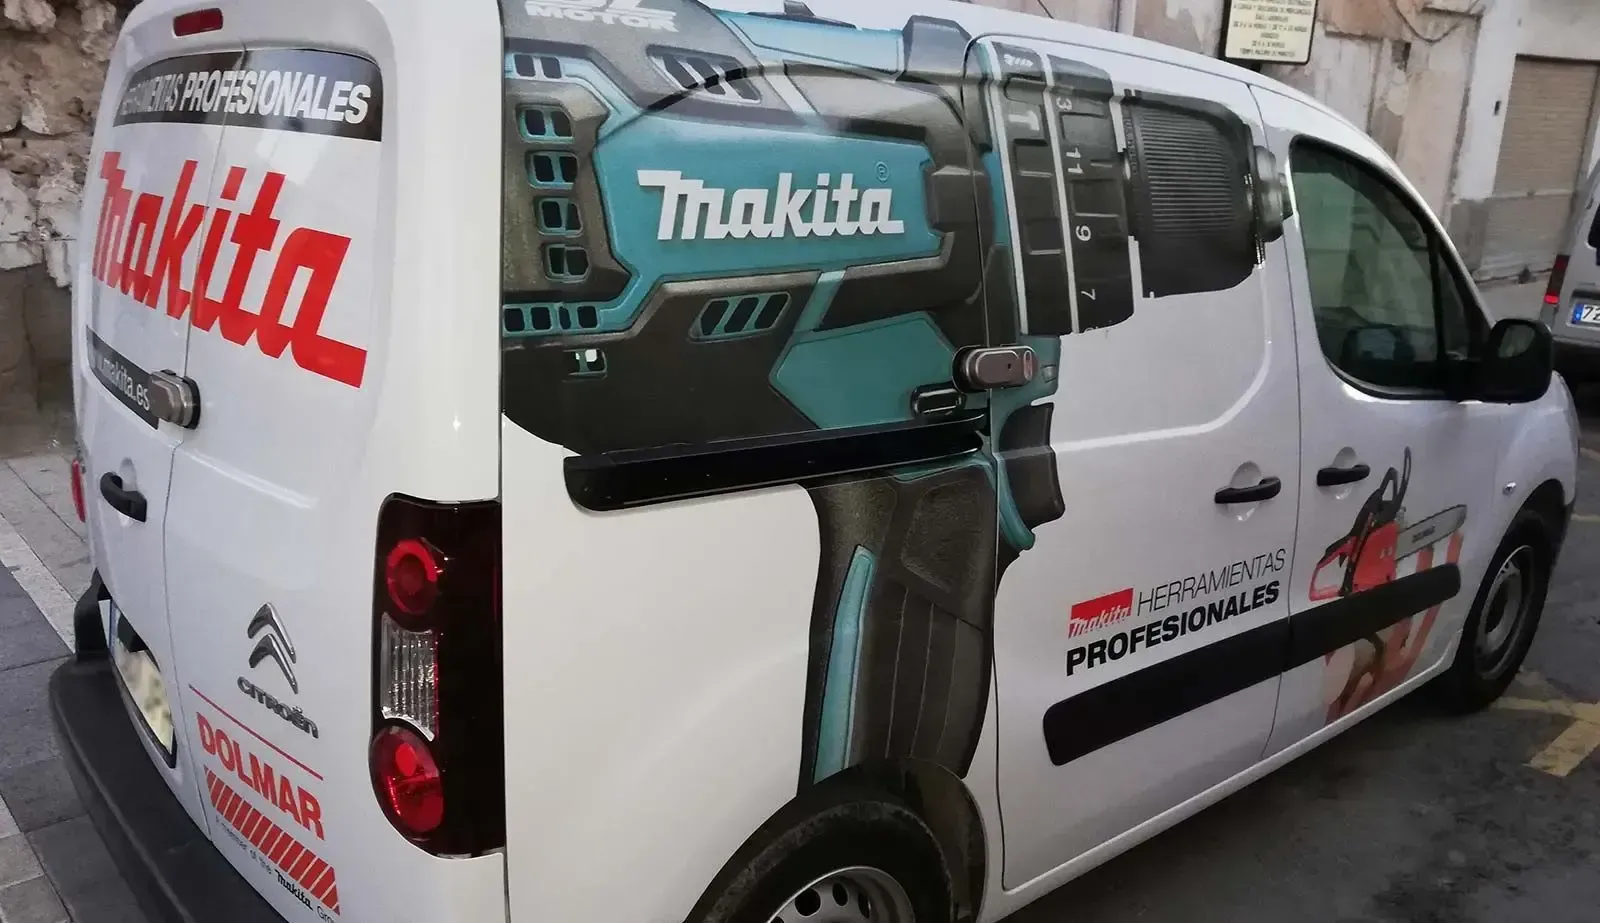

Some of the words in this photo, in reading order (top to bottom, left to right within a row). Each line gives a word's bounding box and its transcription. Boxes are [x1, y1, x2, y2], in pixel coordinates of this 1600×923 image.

[524, 4, 678, 33] MOTOR
[181, 69, 371, 125] PROFESIONALES
[1137, 548, 1286, 617] HERRAMIENTAS
[1066, 580, 1281, 677] PROFESIONALES
[196, 711, 325, 841] DOLMAR
